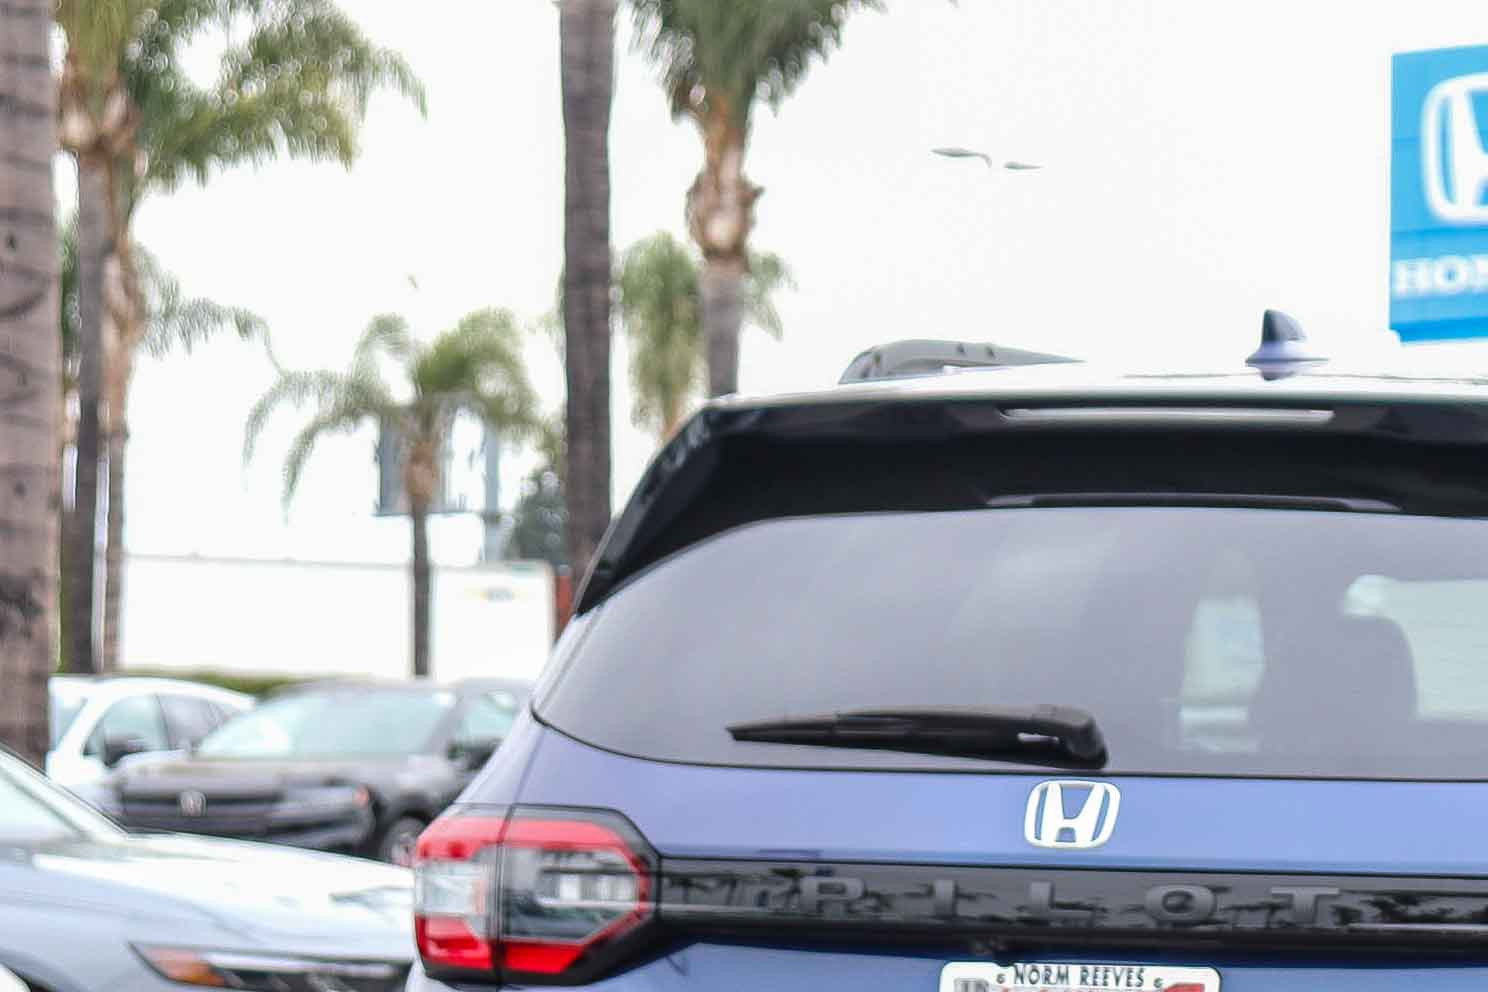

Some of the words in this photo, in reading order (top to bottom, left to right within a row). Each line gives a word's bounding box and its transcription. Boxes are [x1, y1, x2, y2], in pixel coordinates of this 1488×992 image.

[800, 875, 1340, 929] PILOT
[1013, 965, 1070, 986] NORM
[1079, 967, 1147, 989] REEVES
